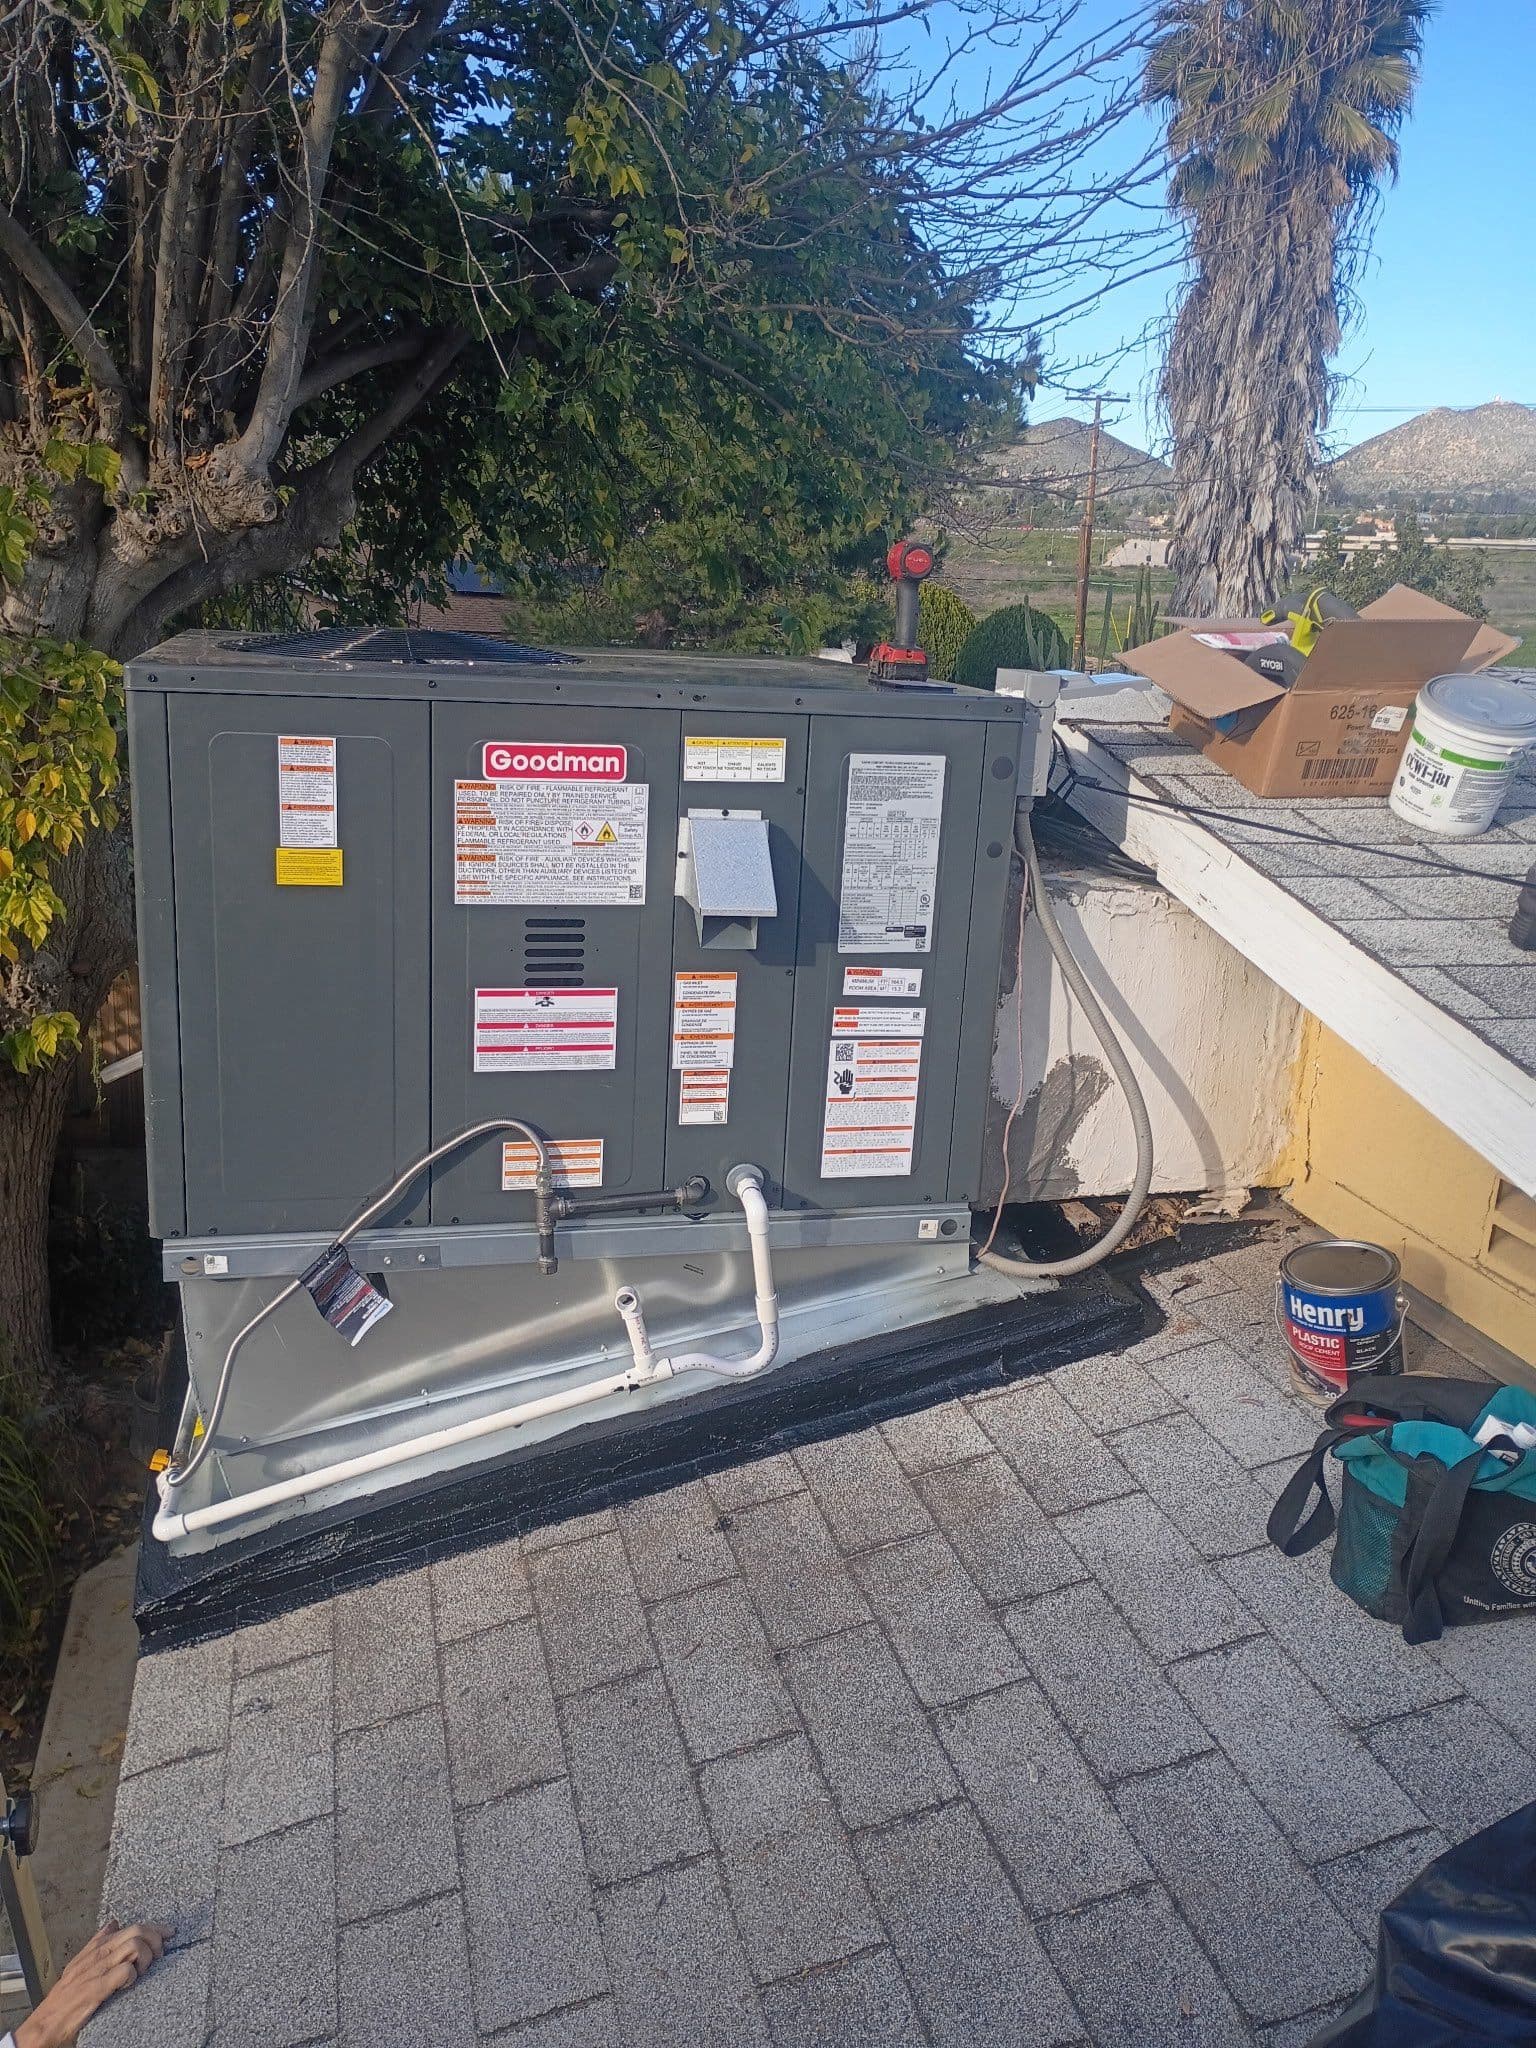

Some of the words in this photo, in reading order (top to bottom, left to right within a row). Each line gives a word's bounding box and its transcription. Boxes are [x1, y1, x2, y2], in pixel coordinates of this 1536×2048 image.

[1260, 659, 1283, 670] RYOBI
[490, 749, 620, 773] Goodman
[1406, 753, 1451, 788] CCWI-181
[1290, 1295, 1364, 1331] Henry
[1292, 1327, 1340, 1348] PLASTIC
[1314, 1347, 1340, 1357] CEMENT
[1356, 1346, 1376, 1354] BLACK
[1463, 1595, 1489, 1611] Uniting
[1492, 1603, 1520, 1611] Families
